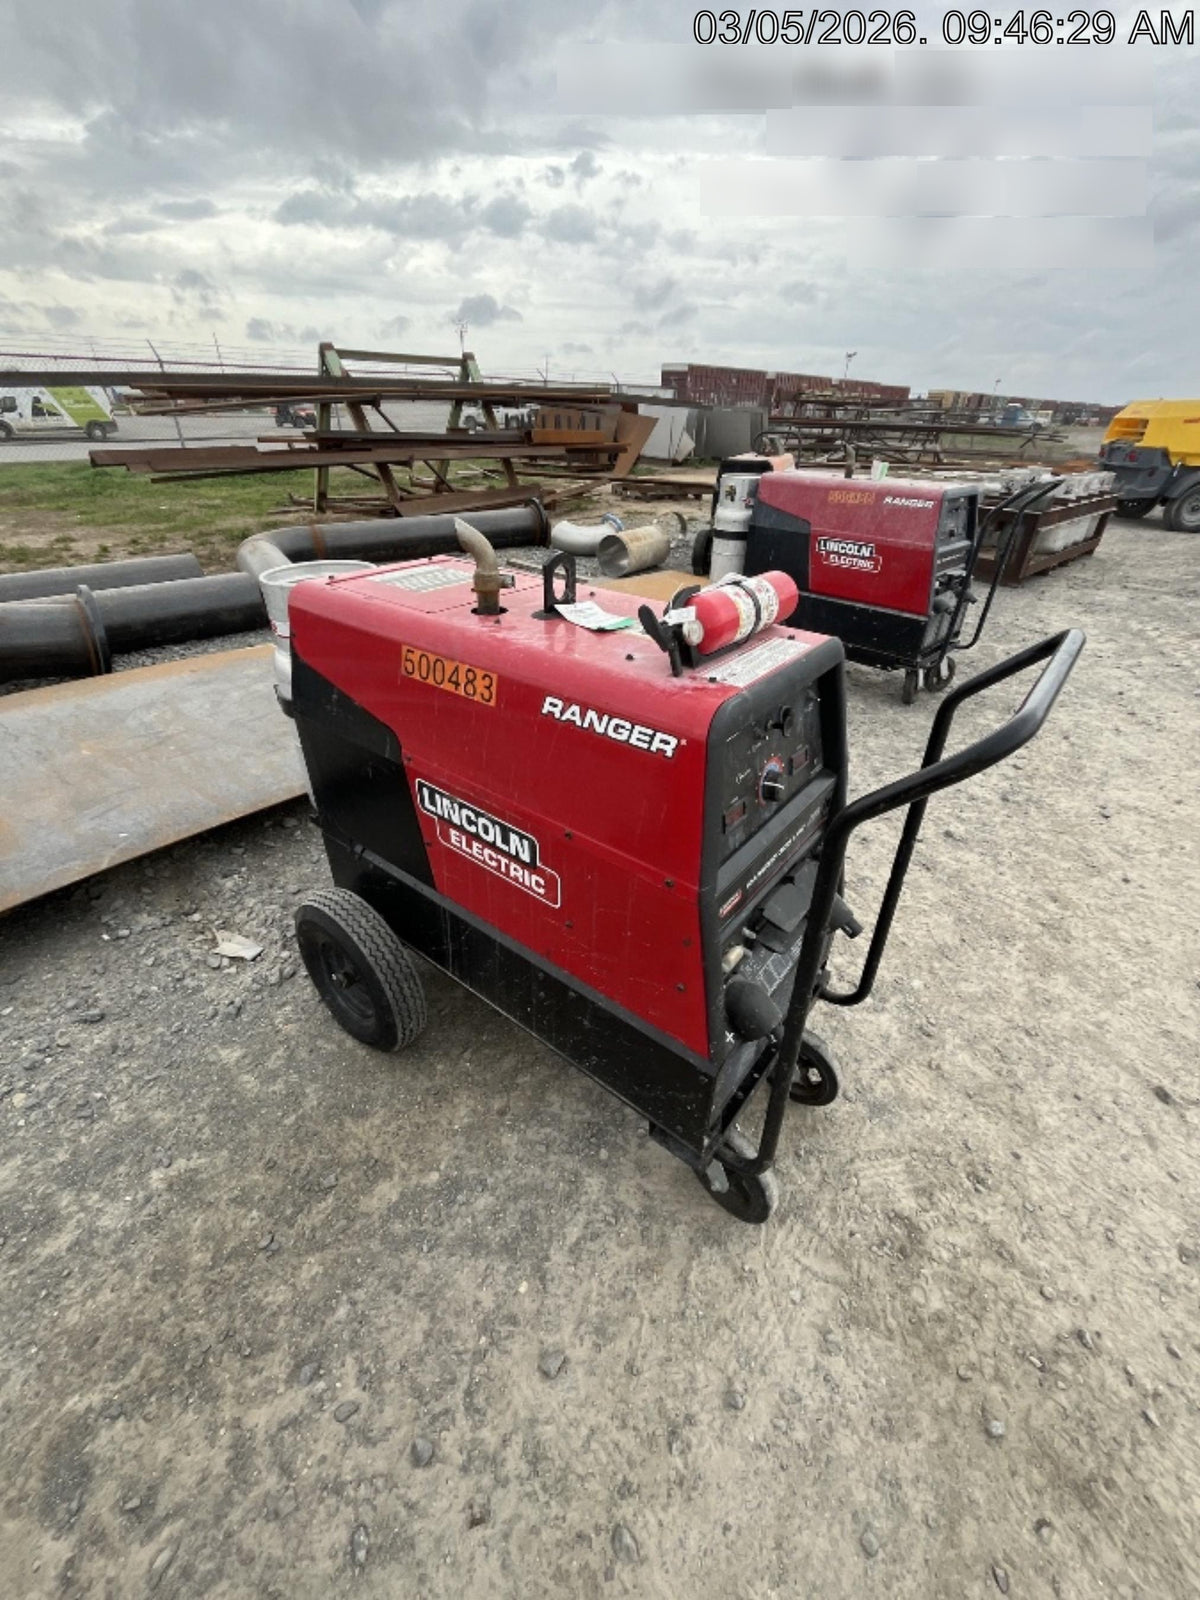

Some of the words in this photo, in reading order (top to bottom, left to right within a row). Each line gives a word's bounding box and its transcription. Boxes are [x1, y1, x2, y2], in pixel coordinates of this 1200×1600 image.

[820, 540, 872, 558] LINCOLN
[829, 553, 875, 570] ELECTRIC
[403, 648, 496, 704] 500483
[541, 695, 679, 758] RANGER
[421, 786, 531, 864] LINCOLN
[448, 827, 546, 896] ELECTRIC
